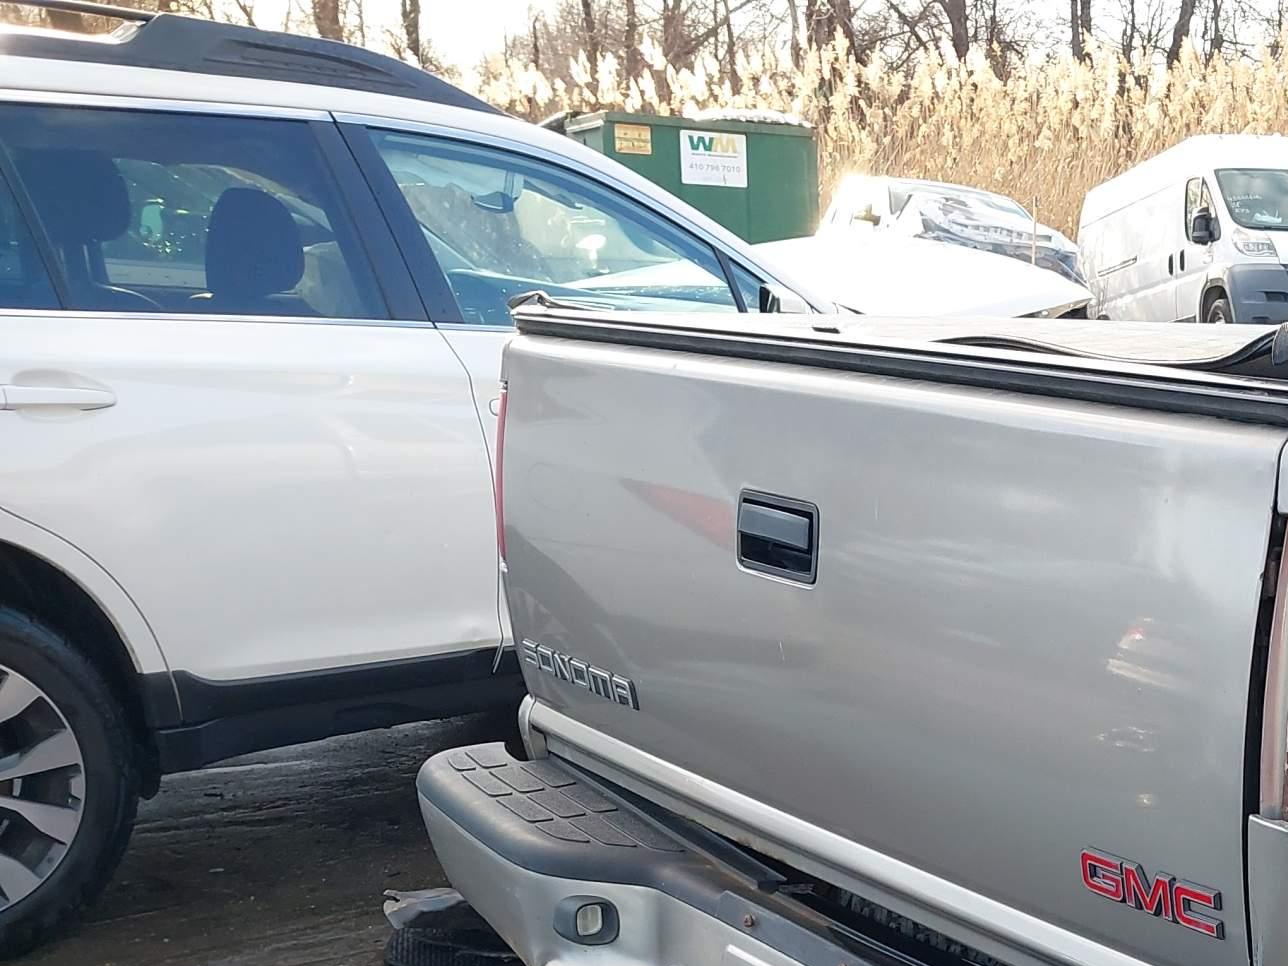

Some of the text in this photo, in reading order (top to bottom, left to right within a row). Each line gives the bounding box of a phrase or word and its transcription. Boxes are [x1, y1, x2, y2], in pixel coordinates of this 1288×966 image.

[688, 134, 738, 154] WM
[522, 638, 640, 711] SONOMA
[1079, 845, 1225, 940] GMC
